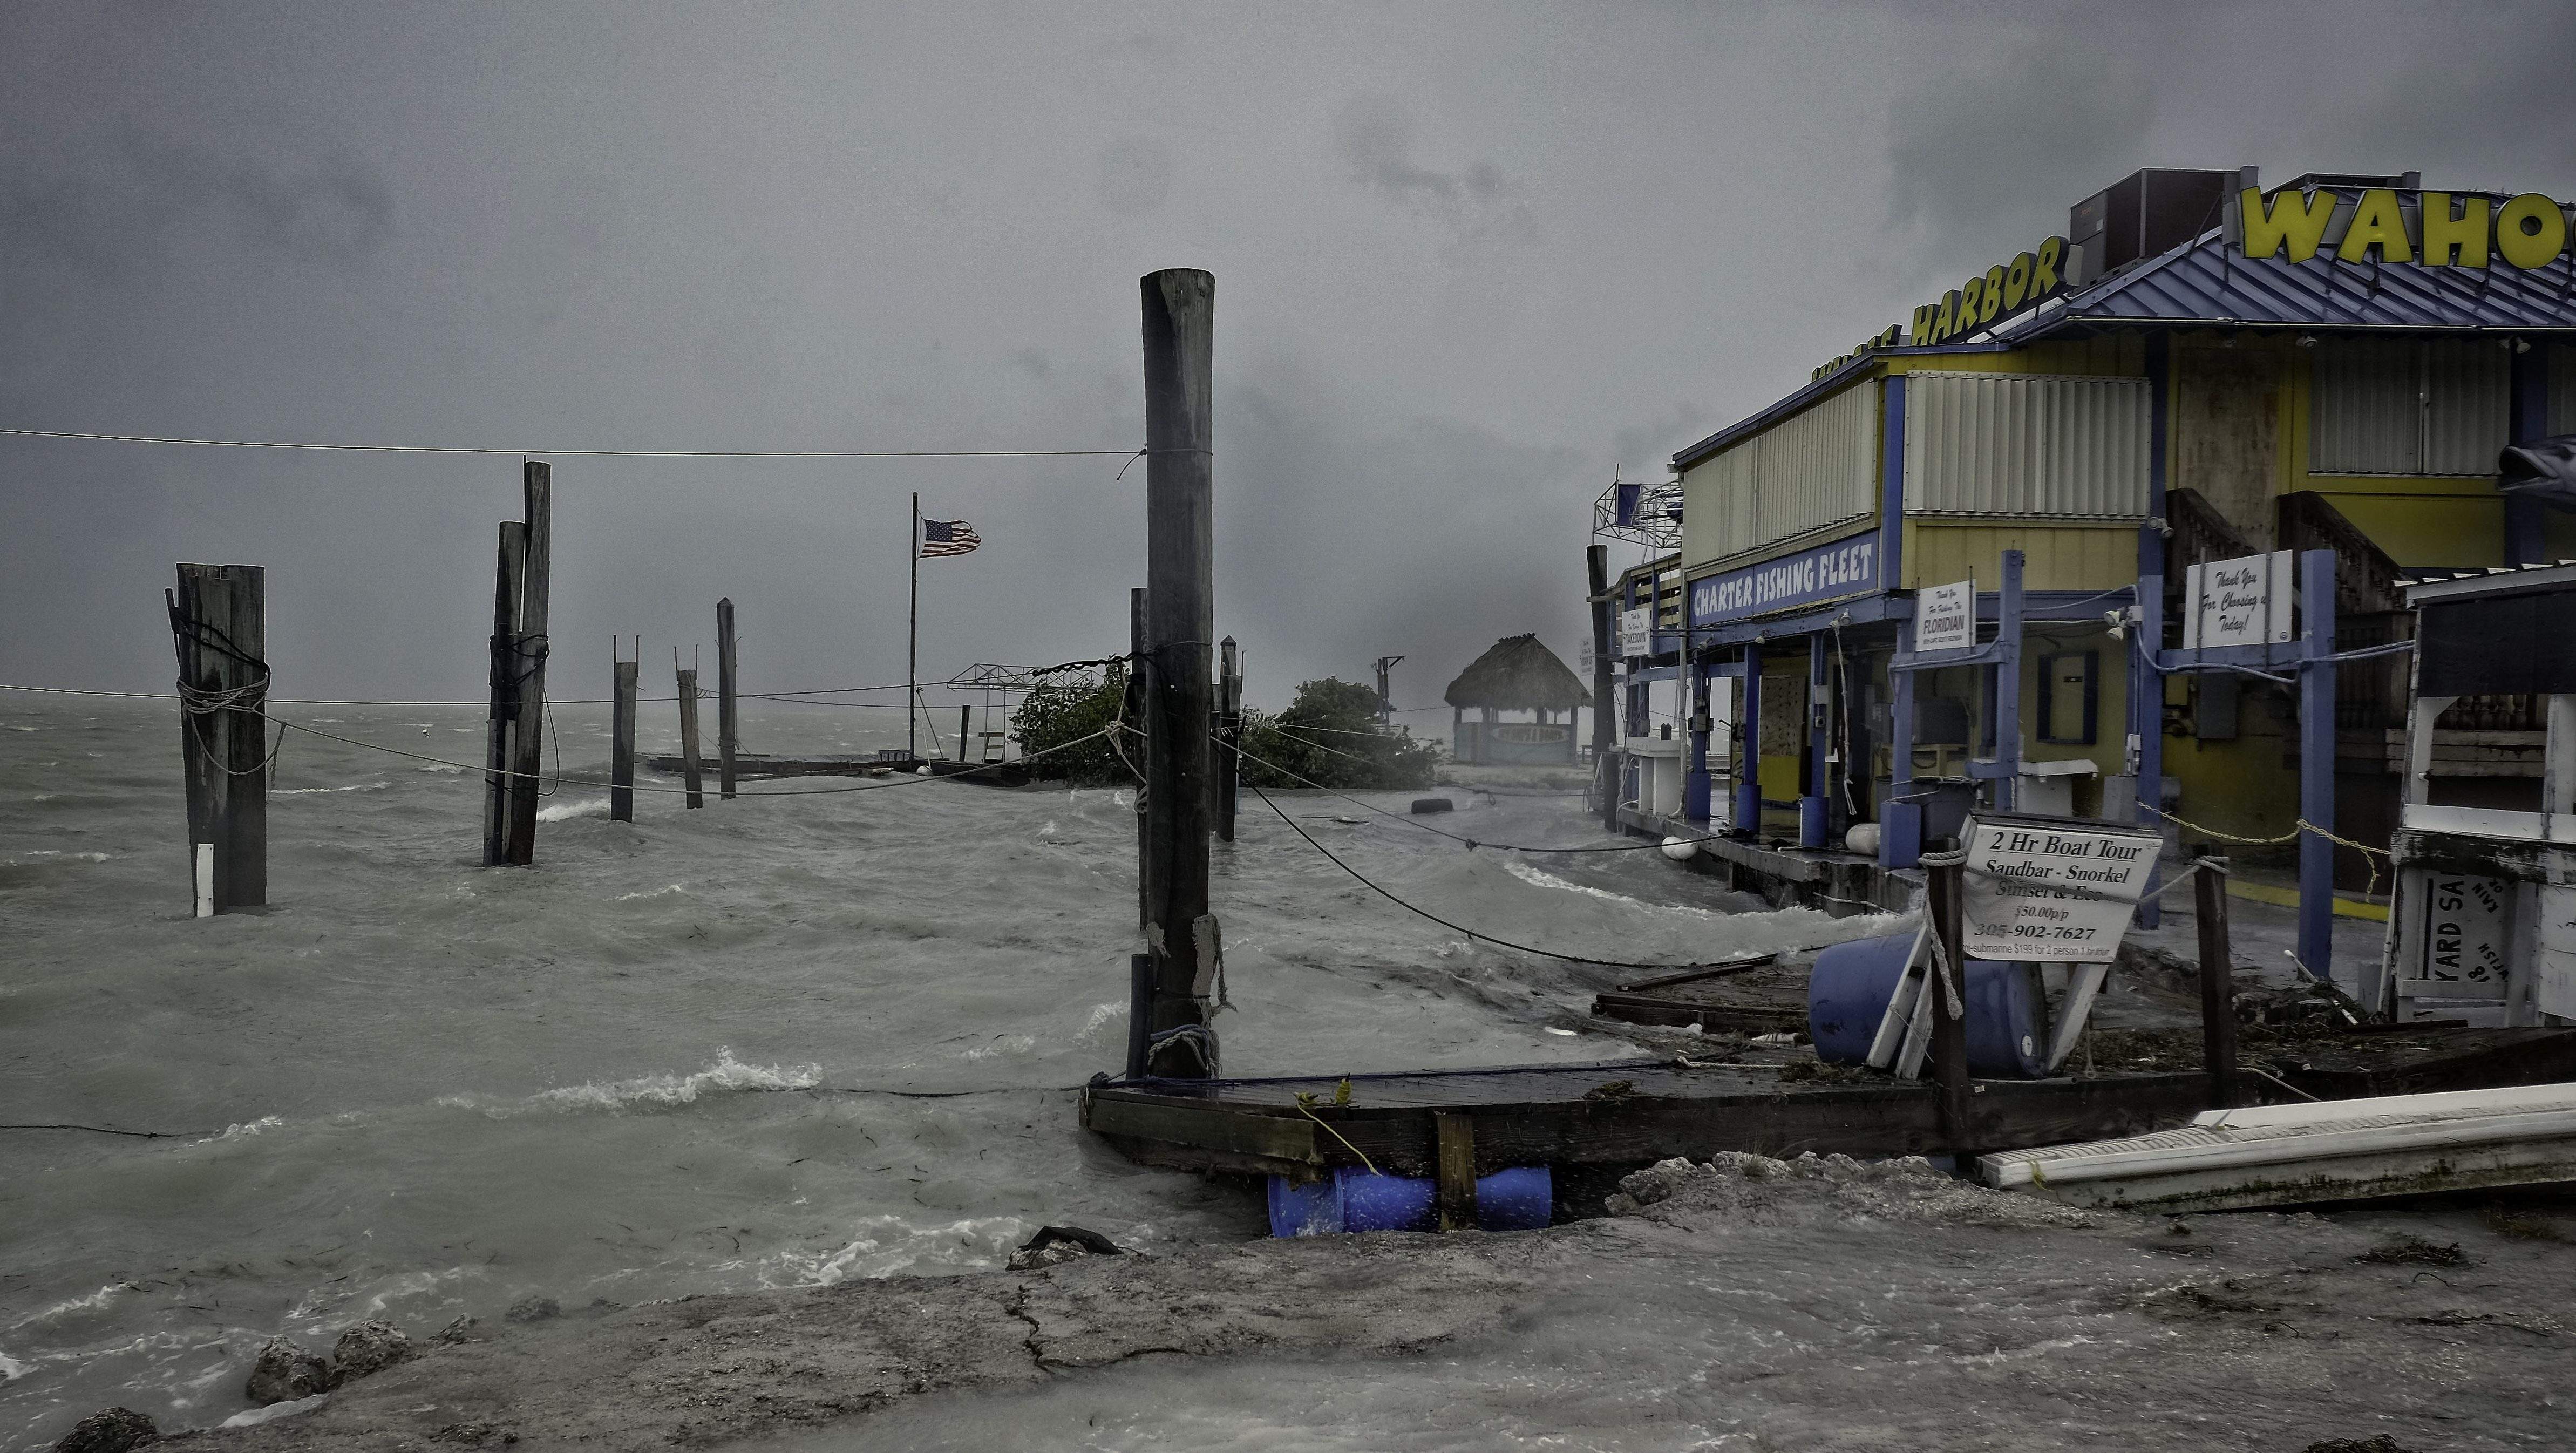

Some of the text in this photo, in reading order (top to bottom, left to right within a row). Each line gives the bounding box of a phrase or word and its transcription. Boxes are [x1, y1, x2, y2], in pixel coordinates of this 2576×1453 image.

[2239, 185, 2576, 270] WAHO
[1910, 235, 2069, 345] HARBOR
[1694, 542, 1873, 616] CHARTER FISHING FLEET
[2215, 567, 2258, 589] Thank You
[2201, 594, 2216, 613] For
[2221, 592, 2258, 612] Choosing
[1923, 615, 1965, 634] FLORIDIAN
[2219, 614, 2249, 635] Today!
[1626, 632, 1646, 644] TAKEDOWN
[1989, 831, 2142, 860] 2 Hr Boat Tour
[1985, 860, 2053, 879] Sandbar
[2065, 865, 2131, 884] Snorkel
[1996, 880, 2050, 899] Sunset
[2472, 882, 2499, 913] RAIN
[1974, 923, 2096, 941] 305-902-7627
[2435, 870, 2466, 982] YARD SA
[2014, 943, 2033, 954] $199
[2034, 944, 2045, 954] for
[2046, 945, 2051, 955] 2
[2053, 947, 2078, 957] person
